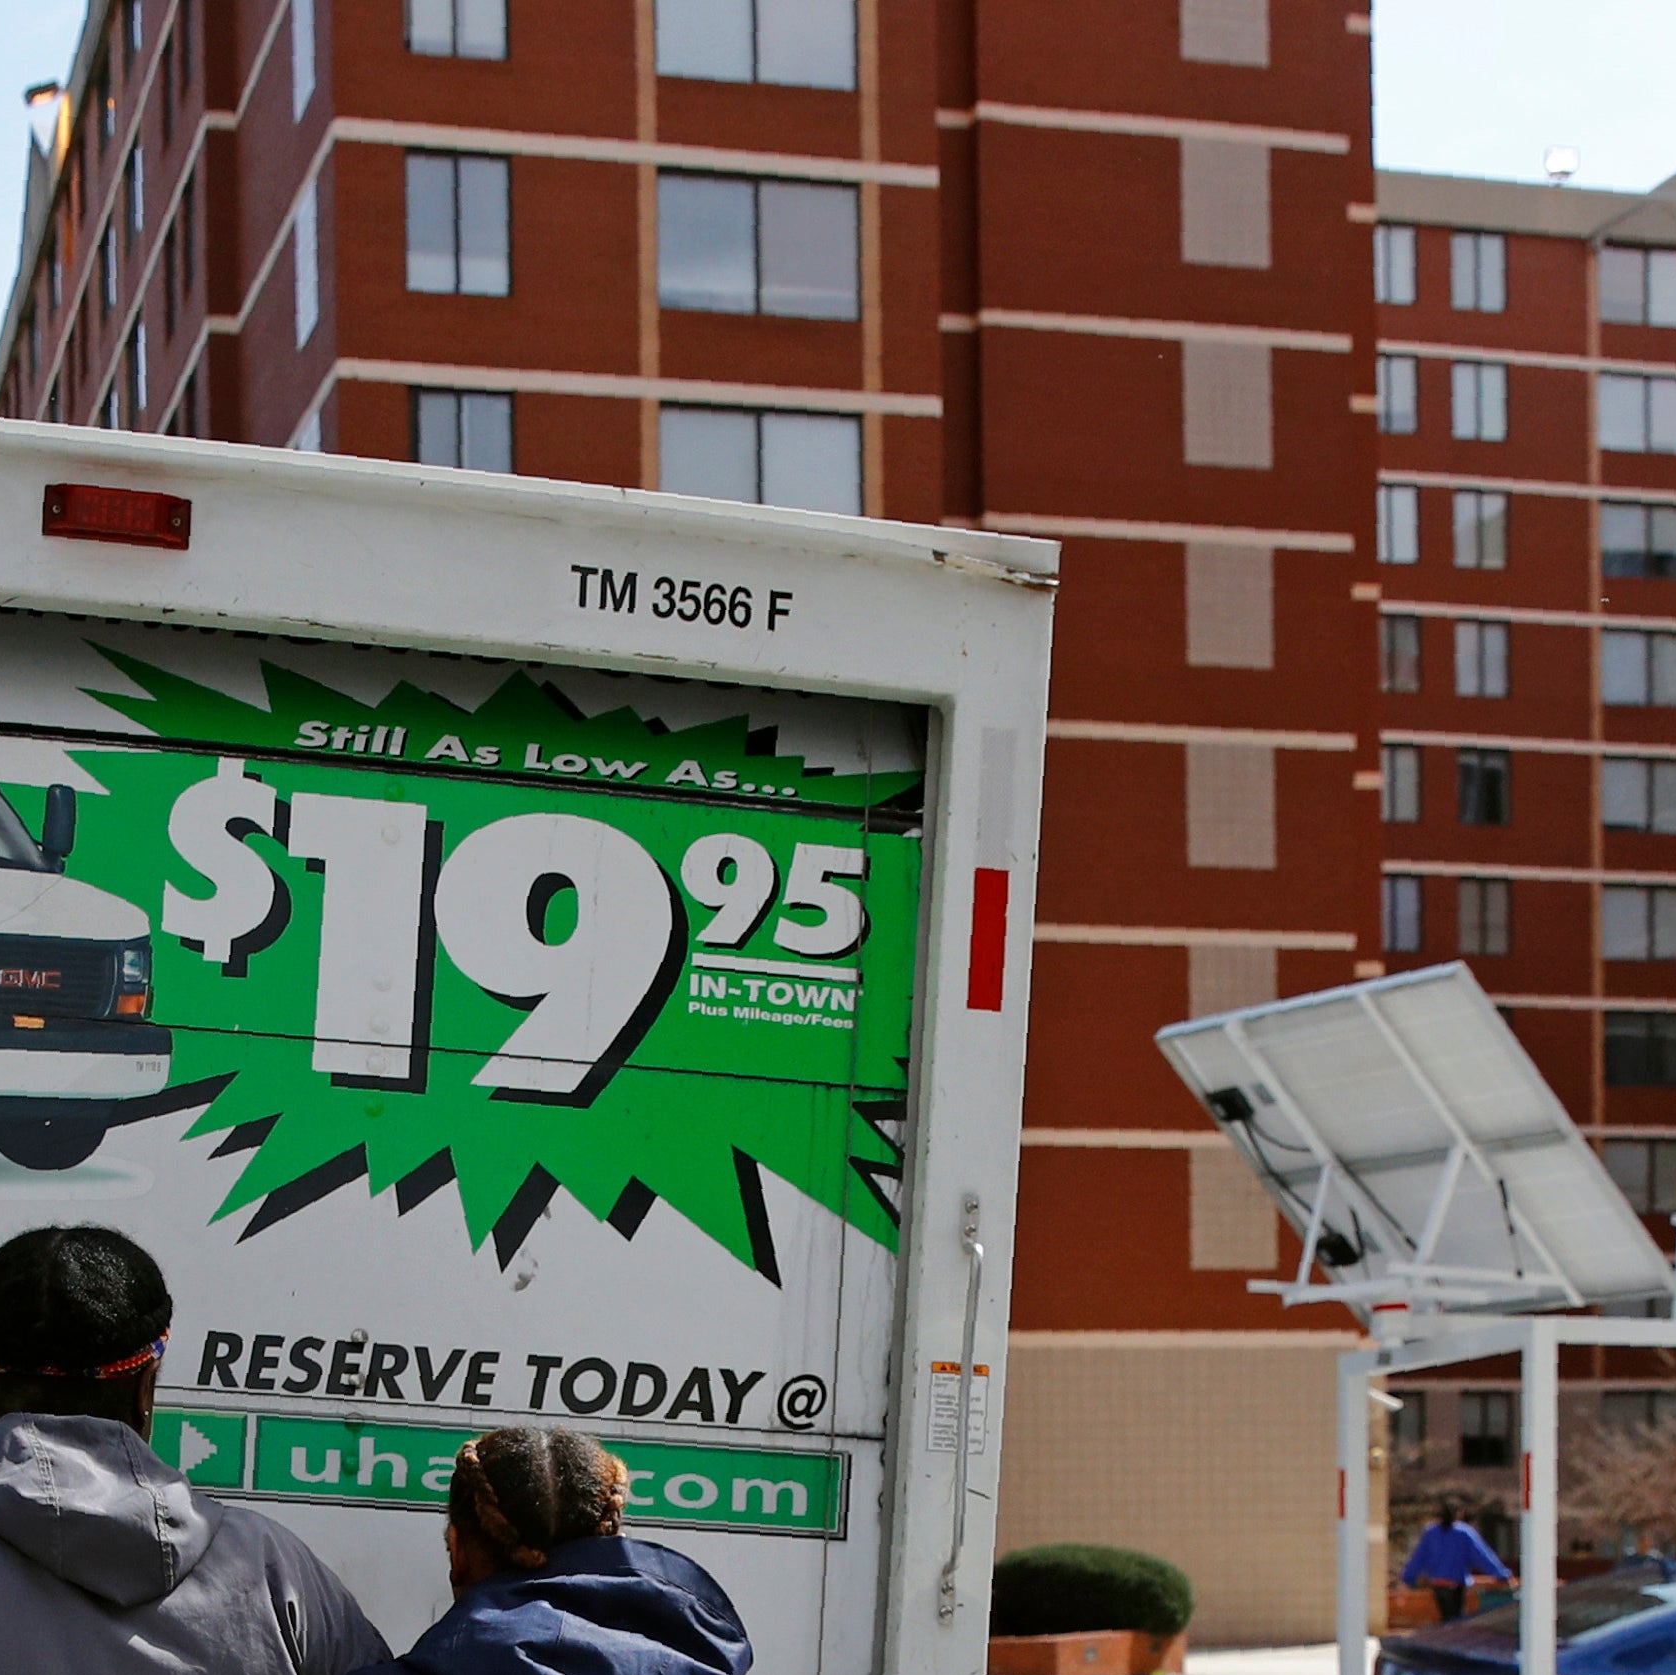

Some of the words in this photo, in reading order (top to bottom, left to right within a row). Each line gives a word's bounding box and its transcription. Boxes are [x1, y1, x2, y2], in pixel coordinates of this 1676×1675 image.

[571, 564, 638, 614] TM
[652, 576, 753, 629] 3566
[767, 589, 794, 632] F
[294, 719, 408, 756] Still
[425, 733, 502, 766] As
[524, 742, 647, 780] Low
[688, 1001, 728, 1017] Plus
[733, 1006, 854, 1030] Mileage/Fees
[689, 973, 856, 1012] IN-TOWN
[198, 1331, 500, 1406] RESERVE
[526, 1354, 765, 1426] TODAY
[777, 1373, 827, 1430] @
